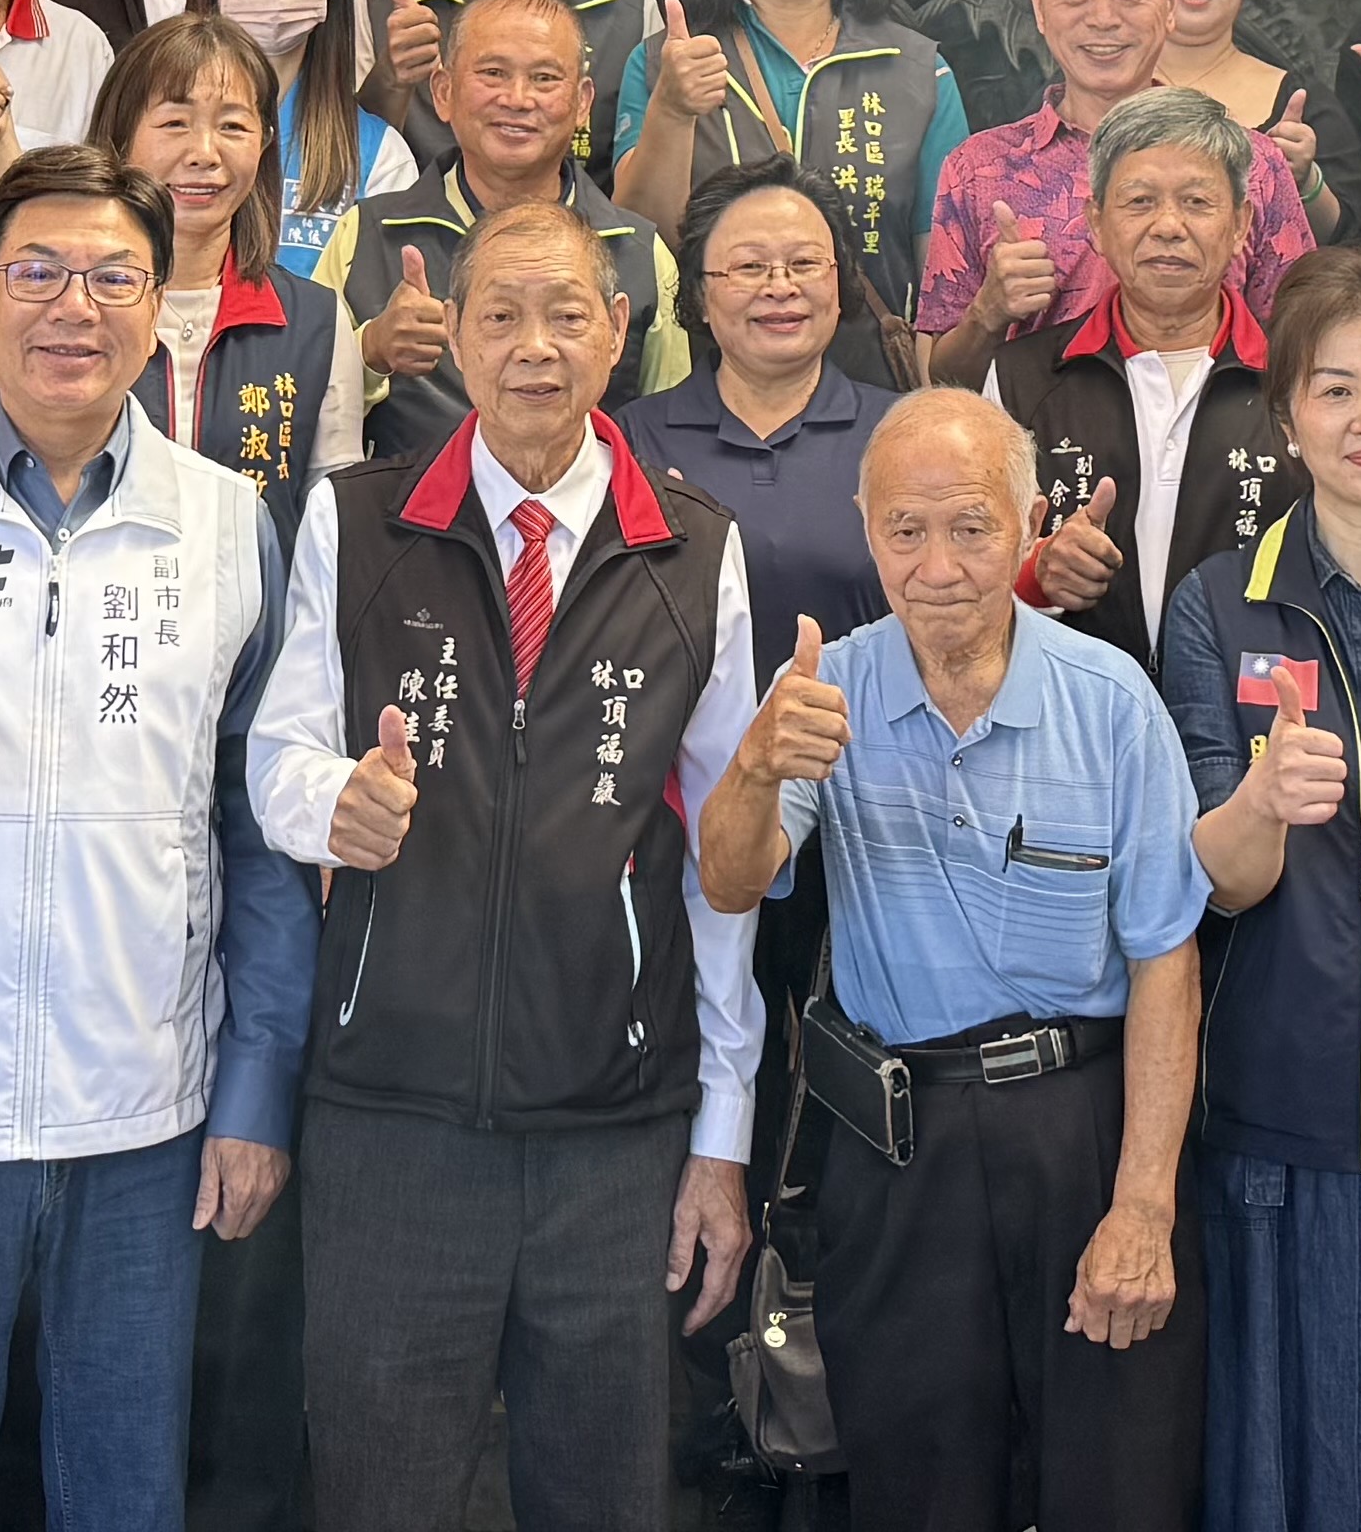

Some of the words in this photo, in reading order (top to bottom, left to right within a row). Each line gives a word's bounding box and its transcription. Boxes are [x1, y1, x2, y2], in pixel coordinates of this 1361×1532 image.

[99, 584, 139, 725] 劉和然
[153, 554, 181, 648] 副市長
[427, 636, 458, 769] 主任委員
